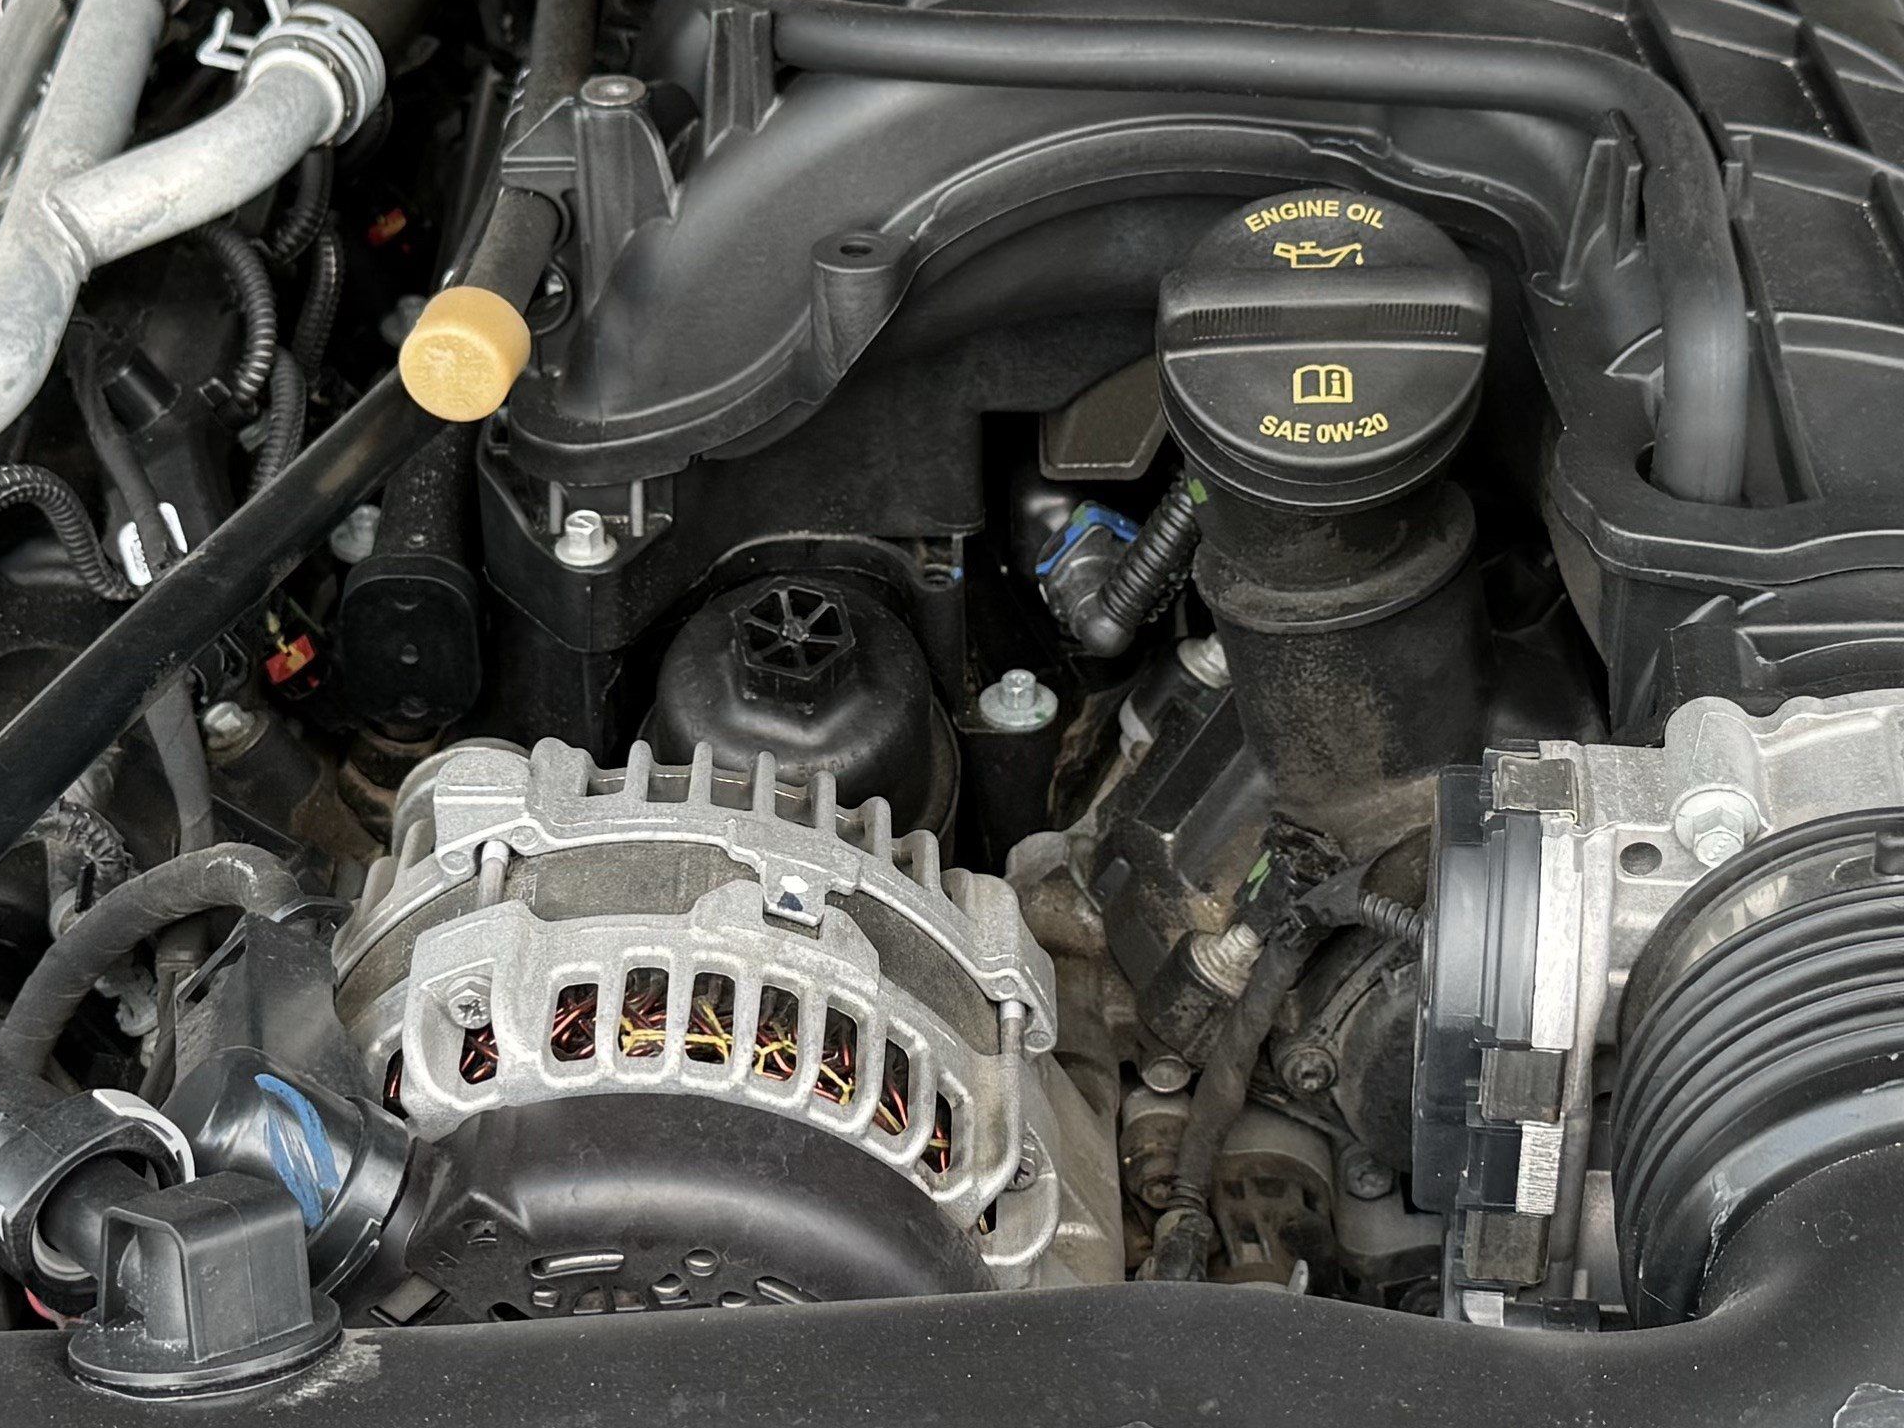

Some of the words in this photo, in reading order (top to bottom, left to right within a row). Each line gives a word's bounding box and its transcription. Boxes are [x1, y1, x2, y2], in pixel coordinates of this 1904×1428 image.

[1243, 199, 1340, 233] ENGINE
[1345, 200, 1385, 230] OIL
[1258, 414, 1312, 444] SAE
[1315, 412, 1390, 444] 0W-20
